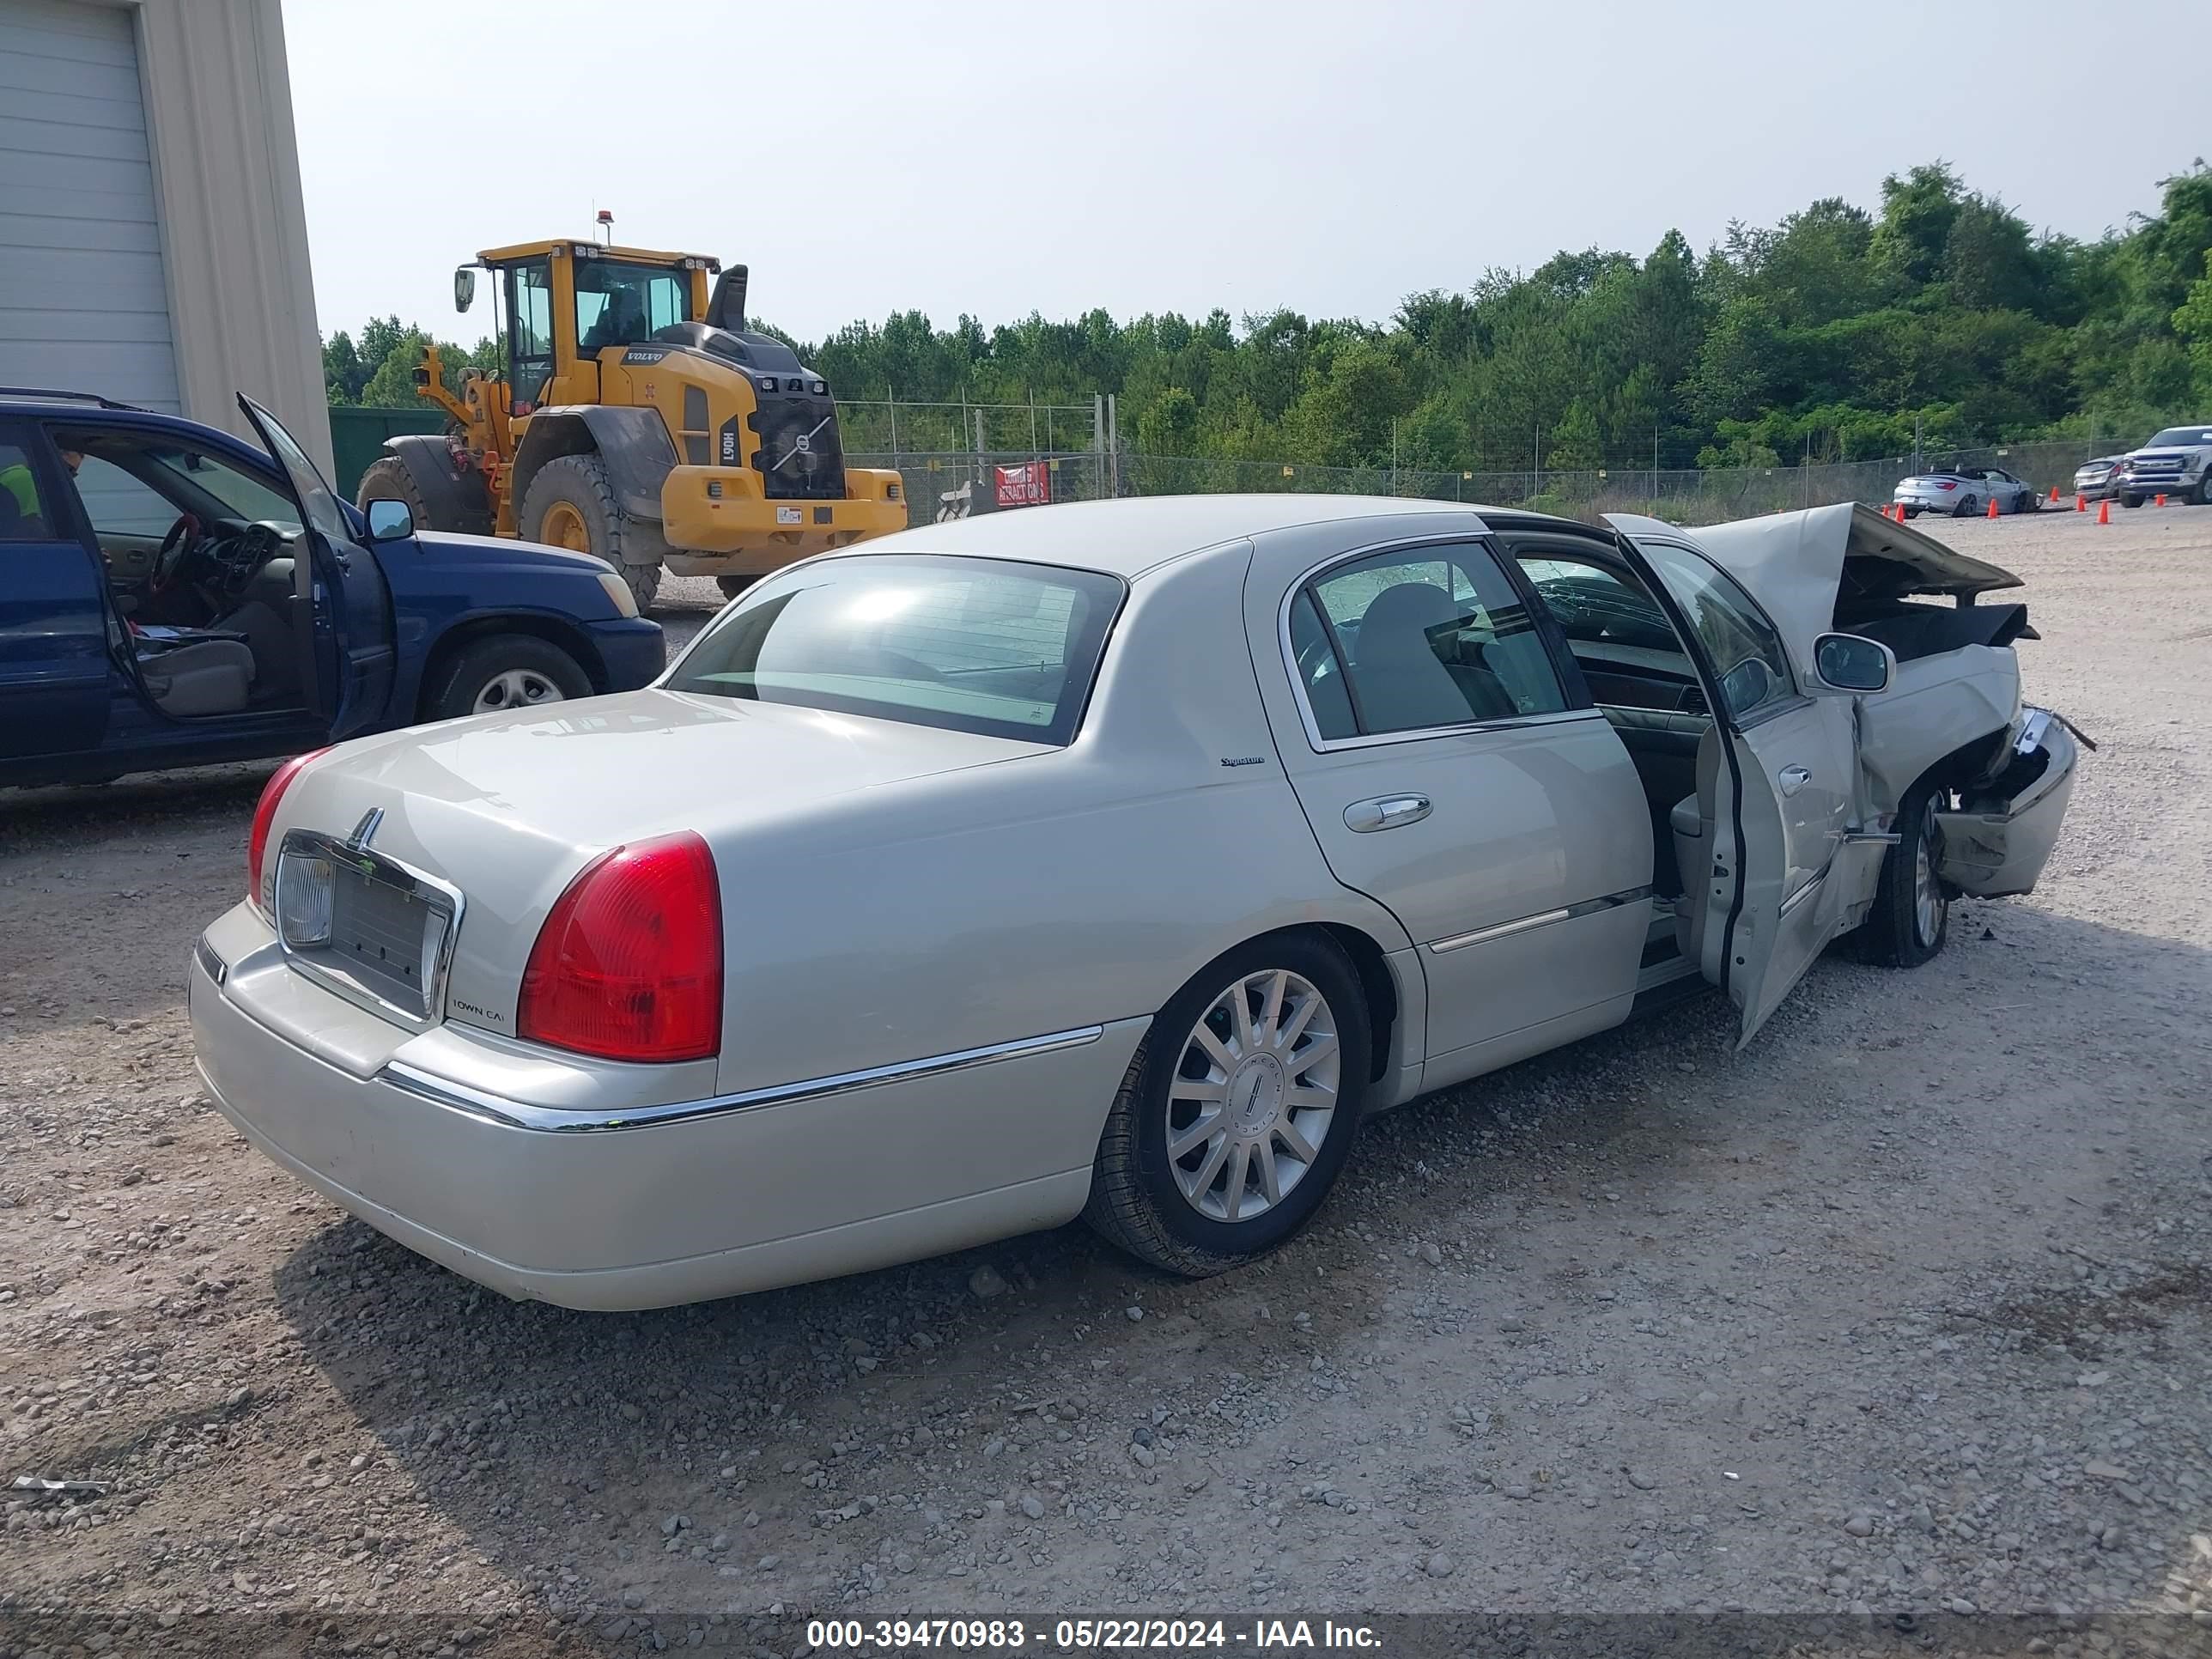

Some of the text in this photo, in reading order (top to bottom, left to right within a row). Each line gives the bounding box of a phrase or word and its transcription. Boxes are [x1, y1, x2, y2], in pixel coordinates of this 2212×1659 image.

[627, 352, 663, 361] VOLVO
[723, 432, 734, 461] L90H
[999, 482, 1045, 501] ATTRACTONS
[1220, 757, 1266, 767] Signature
